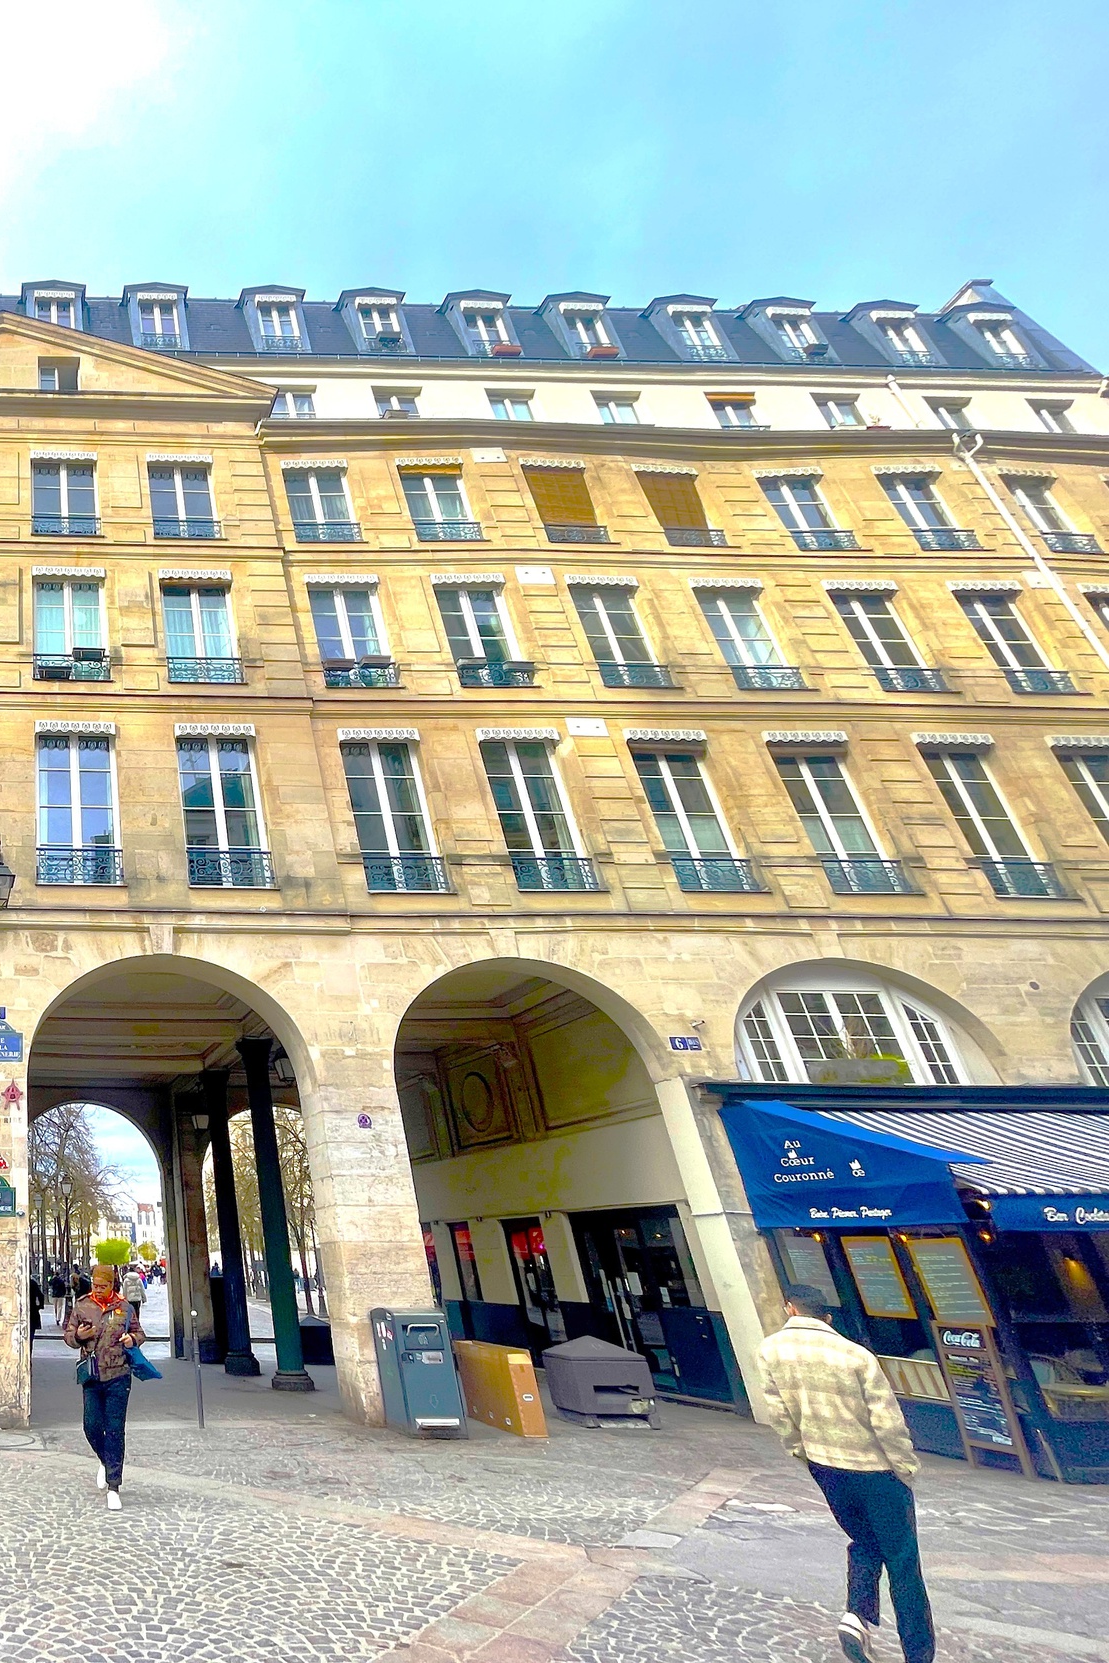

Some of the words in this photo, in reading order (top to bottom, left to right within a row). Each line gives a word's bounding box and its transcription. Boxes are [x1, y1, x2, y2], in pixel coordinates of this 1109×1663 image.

[675, 1037, 683, 1049] 6
[783, 1140, 801, 1149] Au
[780, 1157, 815, 1167] Cœur
[774, 1168, 835, 1183] Couronné
[1043, 1206, 1069, 1222] Bar
